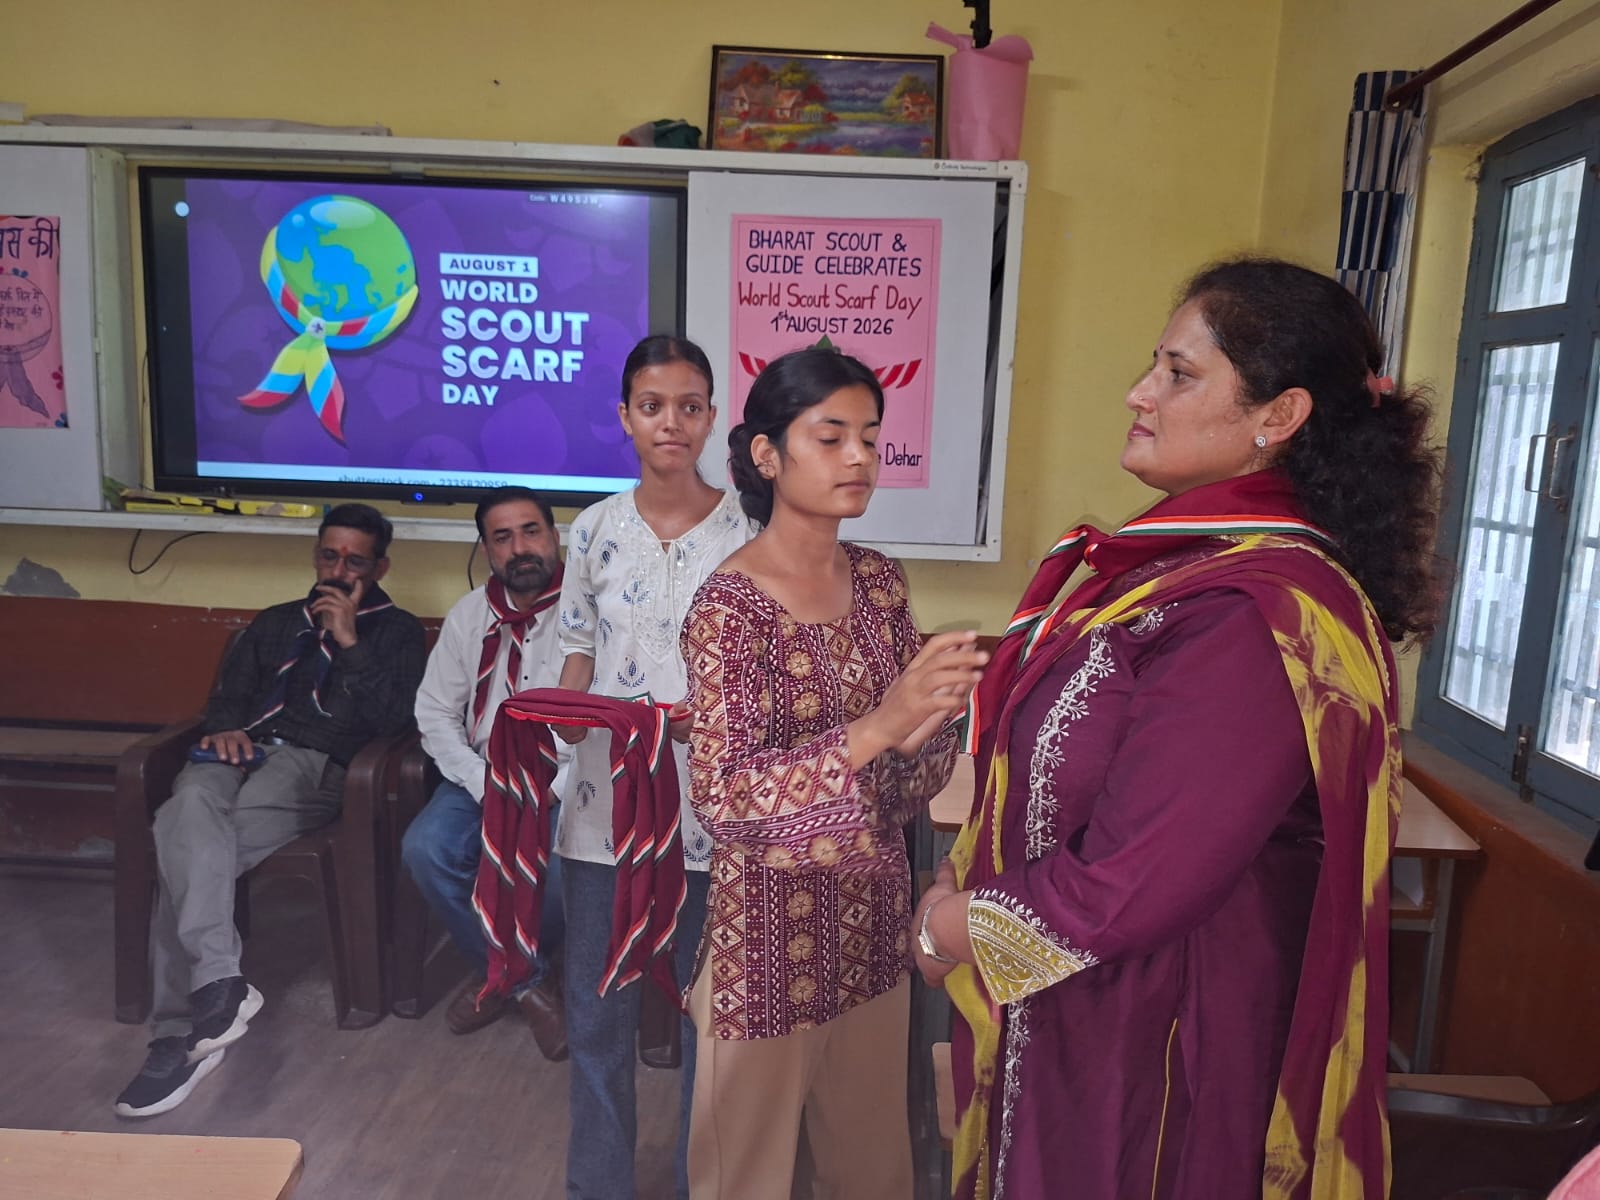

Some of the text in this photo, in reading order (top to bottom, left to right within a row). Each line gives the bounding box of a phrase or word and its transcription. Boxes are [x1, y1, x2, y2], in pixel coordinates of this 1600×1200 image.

[28, 217, 57, 259] की
[749, 229, 907, 252] BHARAT SCOUT &
[449, 258, 531, 273] AUGUST 1
[746, 254, 922, 277] GUIDE CELEBRATES
[440, 278, 539, 304] WORLD
[738, 281, 922, 320] World Scout Scarf Day
[441, 306, 590, 345] SCOUT
[786, 317, 848, 333] AUGUST
[853, 317, 895, 335] 2026
[442, 344, 584, 383] SCARF
[442, 383, 499, 406] DAY
[885, 442, 922, 467] Dehar
